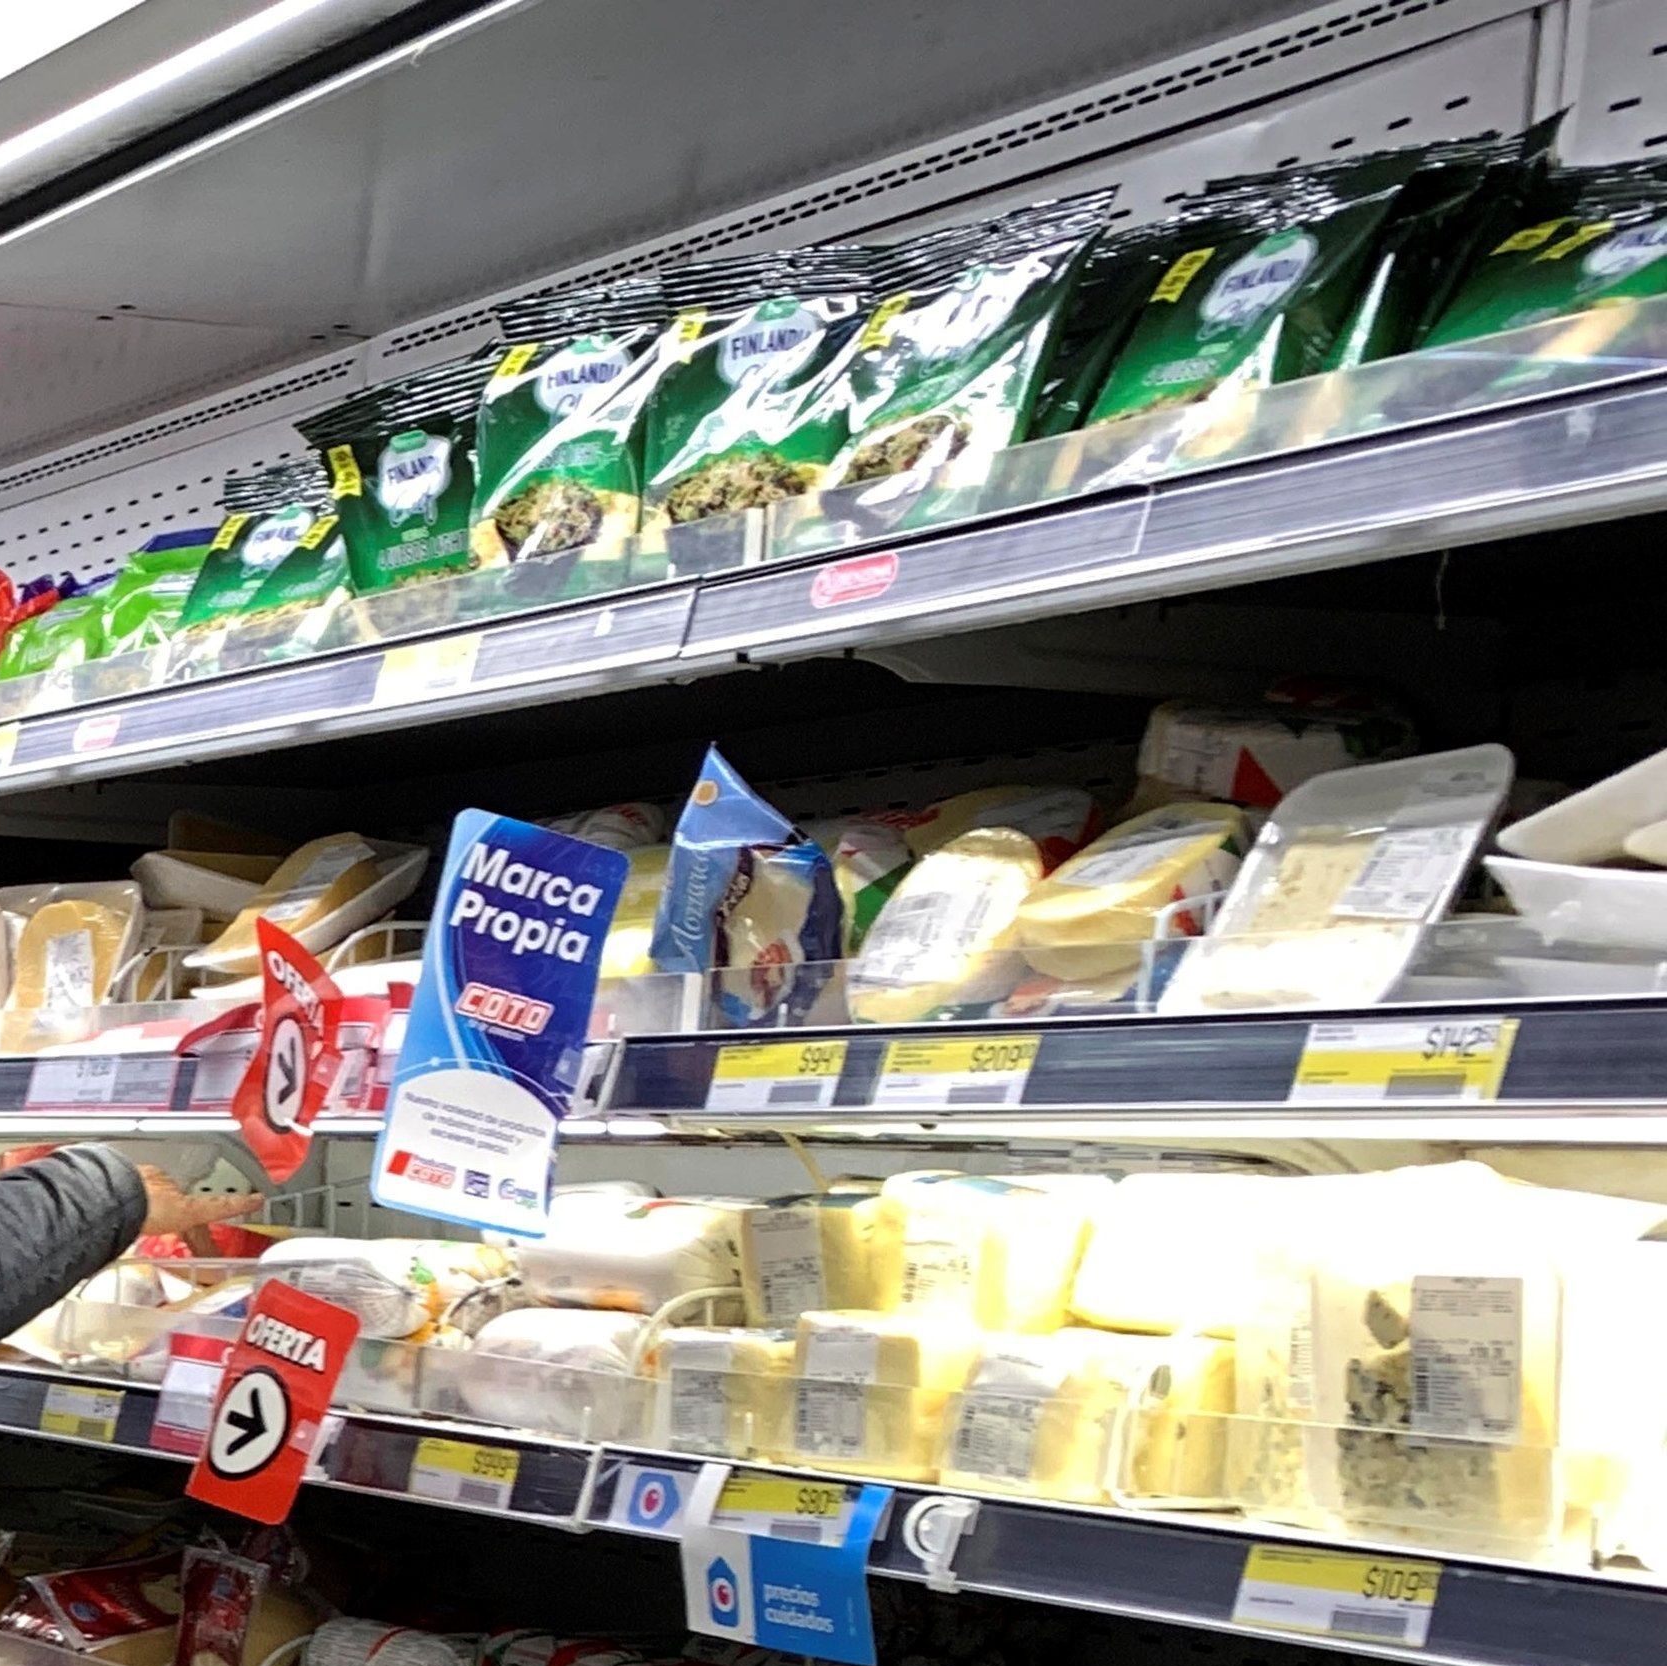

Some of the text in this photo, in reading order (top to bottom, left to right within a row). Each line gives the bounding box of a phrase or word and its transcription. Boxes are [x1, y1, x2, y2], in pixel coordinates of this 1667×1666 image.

[461, 842, 604, 917] Marca
[449, 889, 591, 964] Propia
[458, 985, 549, 1030] COTO
[246, 1312, 328, 1373] OFERTA
[763, 1583, 821, 1608] precios
[764, 1604, 834, 1633] cuidados
